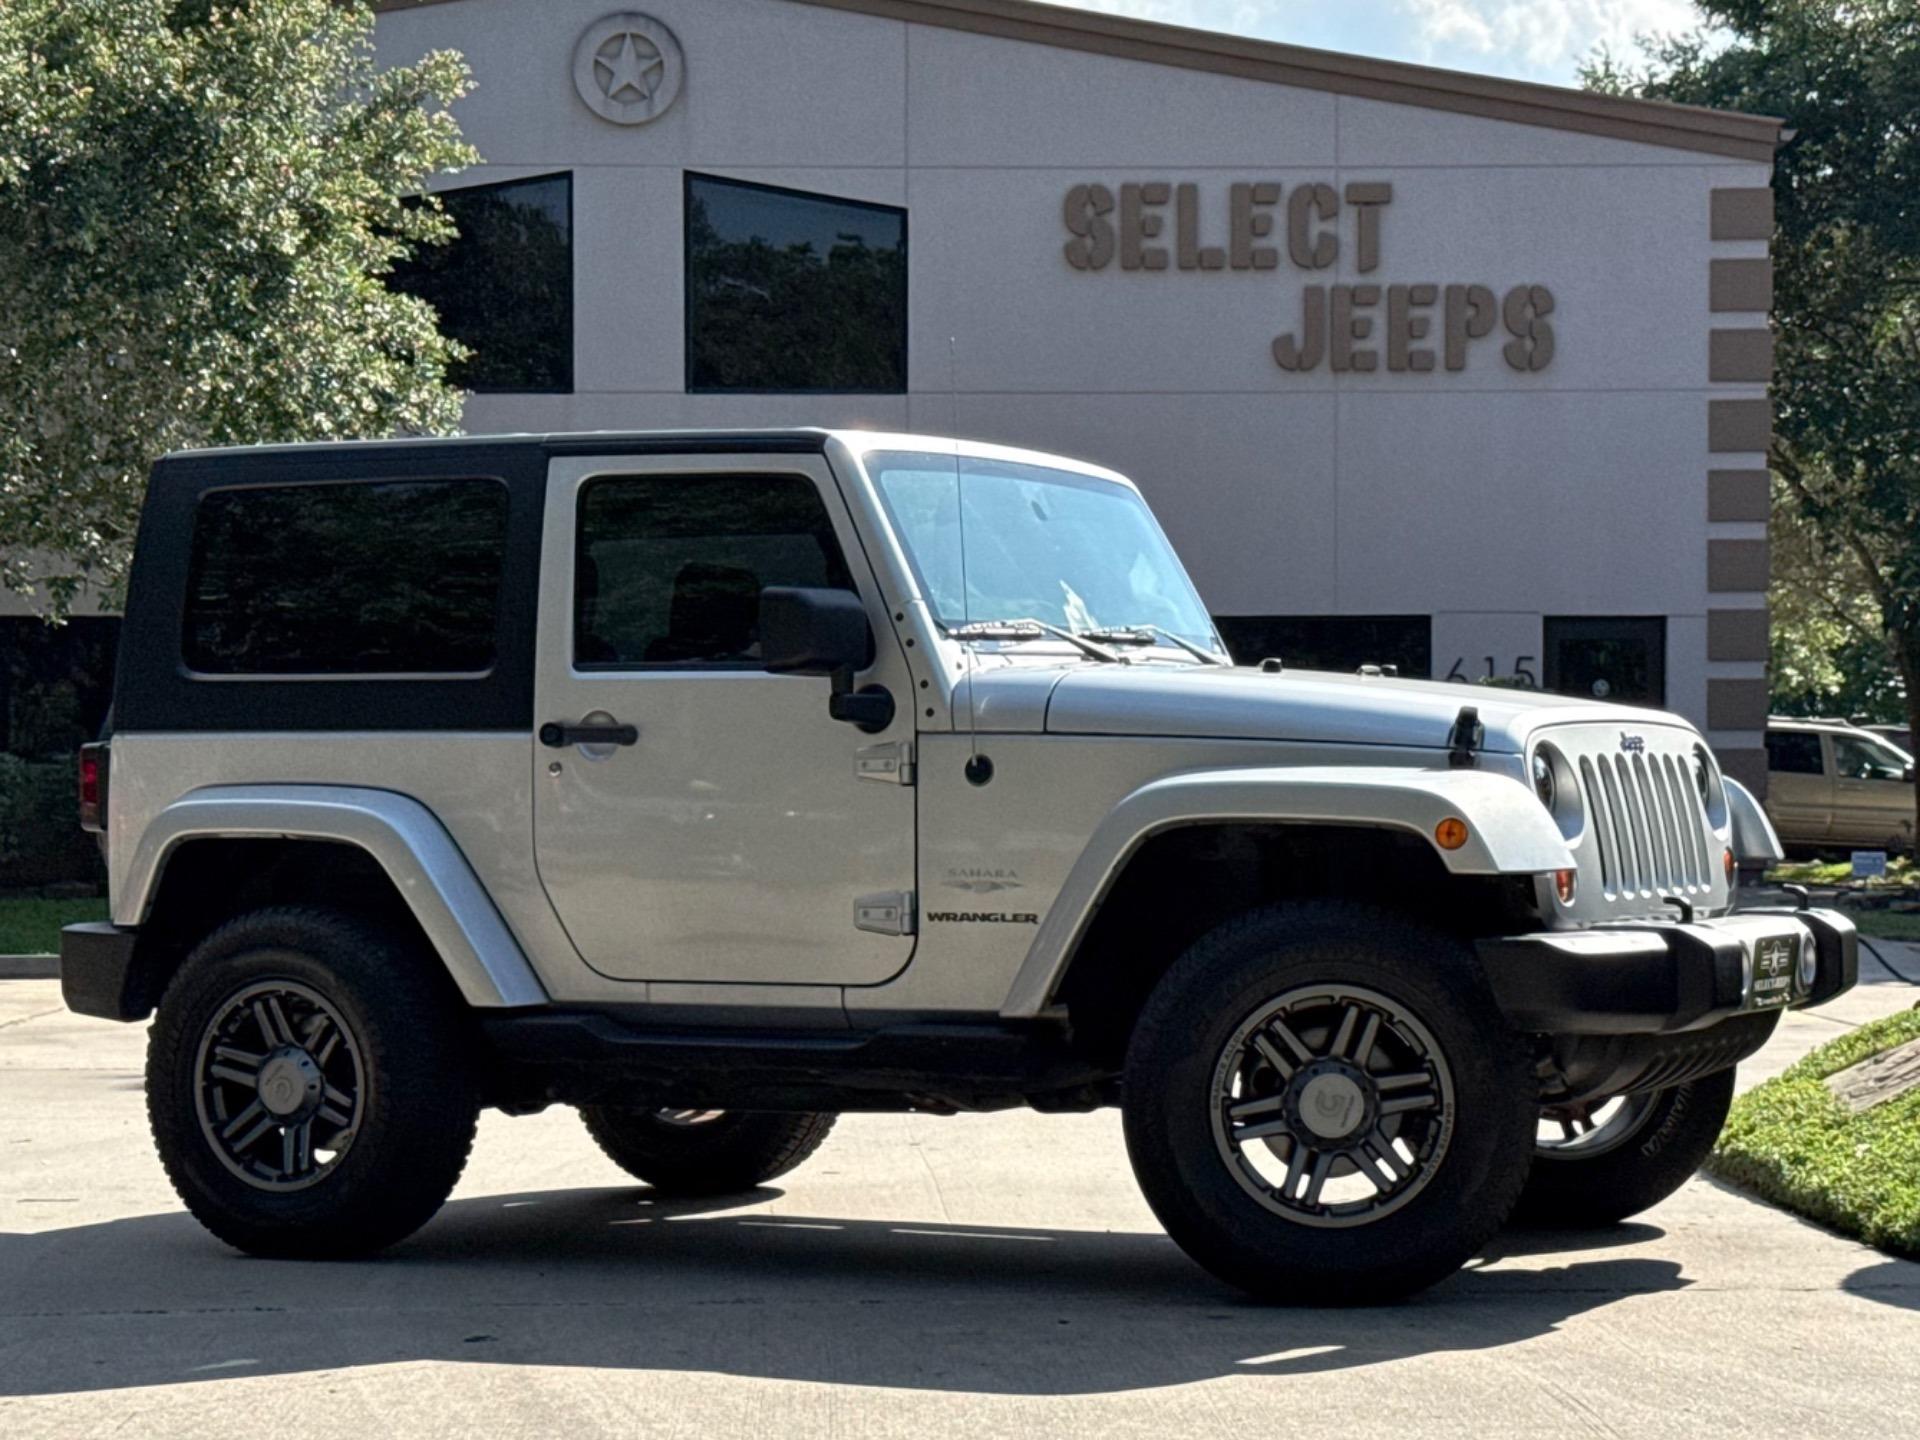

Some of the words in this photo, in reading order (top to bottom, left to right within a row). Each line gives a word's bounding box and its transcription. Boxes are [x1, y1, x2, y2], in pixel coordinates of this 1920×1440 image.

[1063, 182, 1392, 273] SELECT
[1272, 284, 1555, 373] JEEPS
[947, 868, 1018, 878] SAHARA
[927, 911, 1039, 924] WRANGLER
